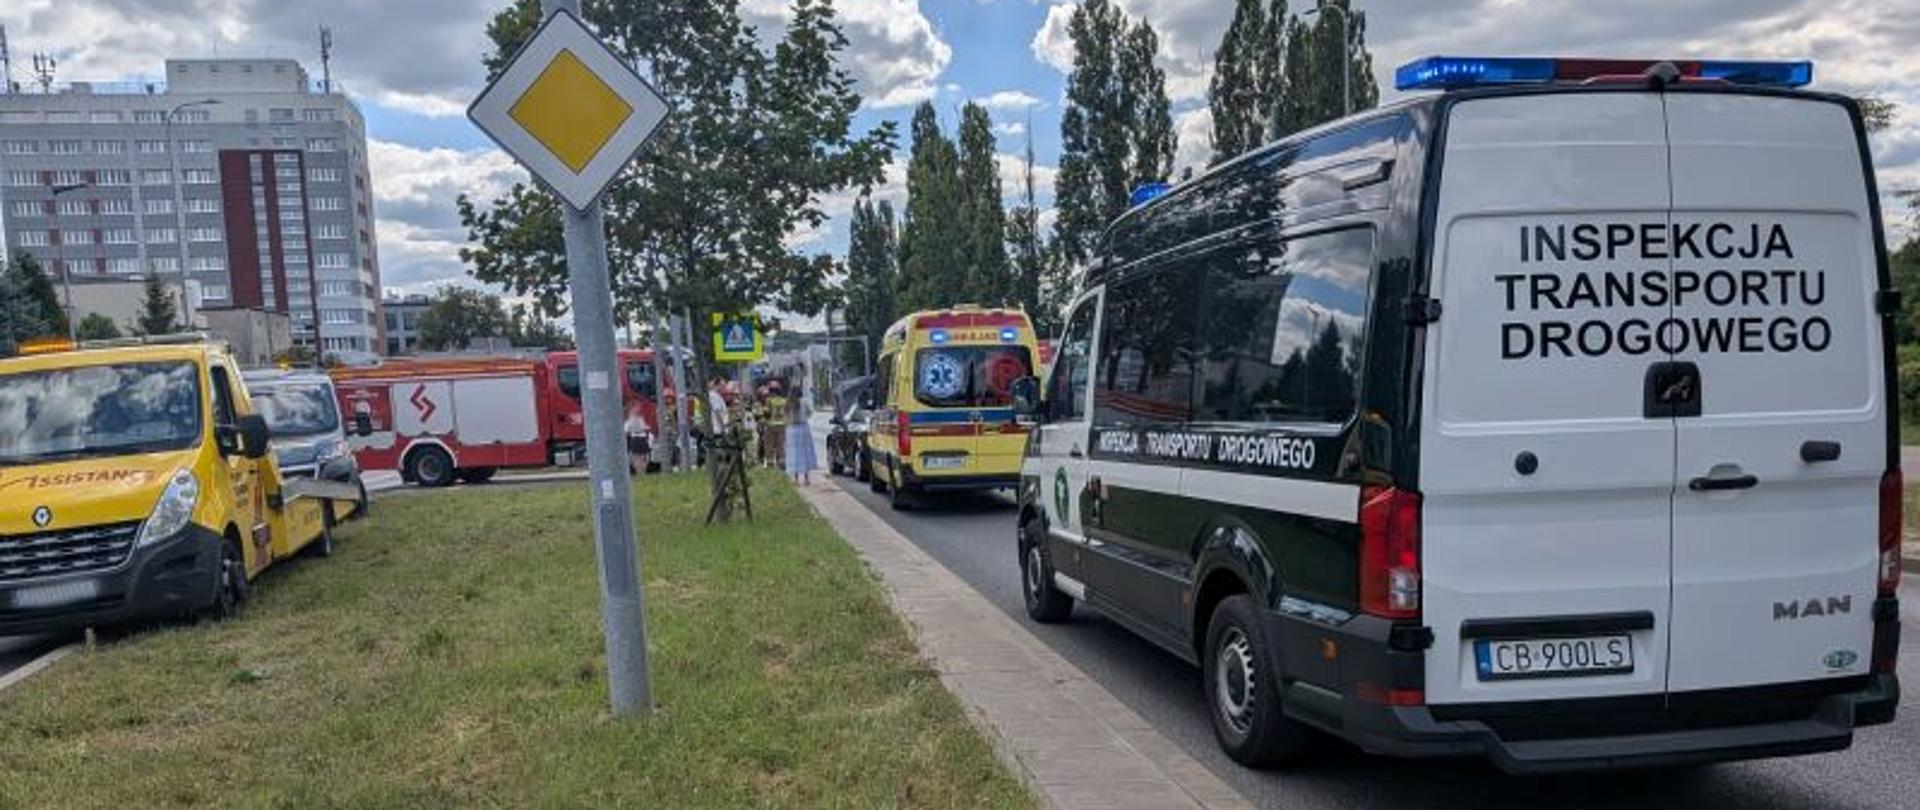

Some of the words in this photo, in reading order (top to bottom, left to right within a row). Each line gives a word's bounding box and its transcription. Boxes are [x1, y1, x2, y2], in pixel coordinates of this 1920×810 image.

[1519, 223, 1794, 262] INSPEKCJA
[1495, 270, 1826, 311] TRANSPORTU
[1501, 316, 1832, 360] DROGOWEGO
[1146, 432, 1213, 460] TRANSPORTU
[1218, 435, 1316, 469] DROGOWEGO
[1773, 595, 1851, 620] MAN
[1497, 643, 1531, 671] CB
[1542, 638, 1624, 669] 900LS
